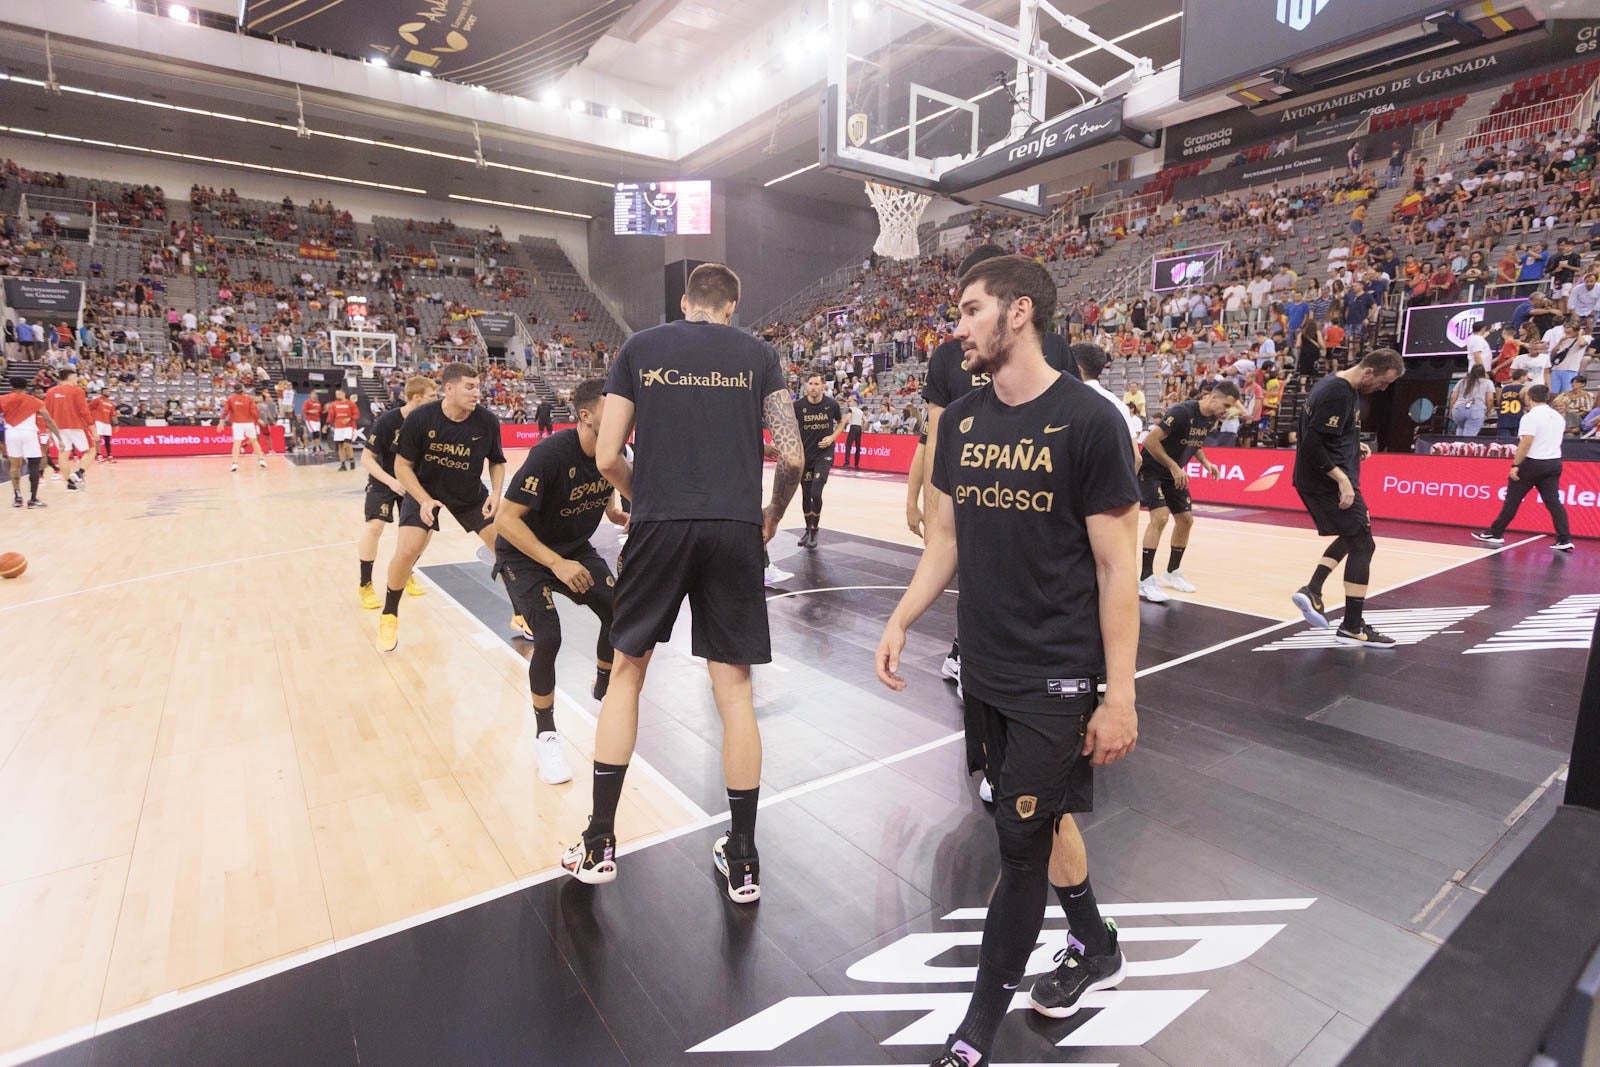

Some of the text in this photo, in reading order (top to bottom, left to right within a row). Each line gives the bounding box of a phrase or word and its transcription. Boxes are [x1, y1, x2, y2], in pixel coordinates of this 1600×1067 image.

[1575, 40, 1597, 54] es
[1008, 128, 1058, 162] renfe
[1183, 128, 1233, 147] Granada
[1183, 137, 1231, 156] es deporte
[664, 369, 748, 388] CaixaBank
[1500, 399, 1521, 414] 30
[803, 412, 829, 422] ESPAÑA
[143, 435, 155, 445] el
[156, 435, 200, 445] Talento
[211, 434, 233, 444] vola
[429, 443, 471, 457] ESPAÑA
[873, 446, 892, 457] volar
[960, 438, 1053, 473] ESPAÑA
[424, 454, 470, 470] endesa
[1383, 475, 1491, 500] Ponemos
[955, 481, 1054, 513] endesa
